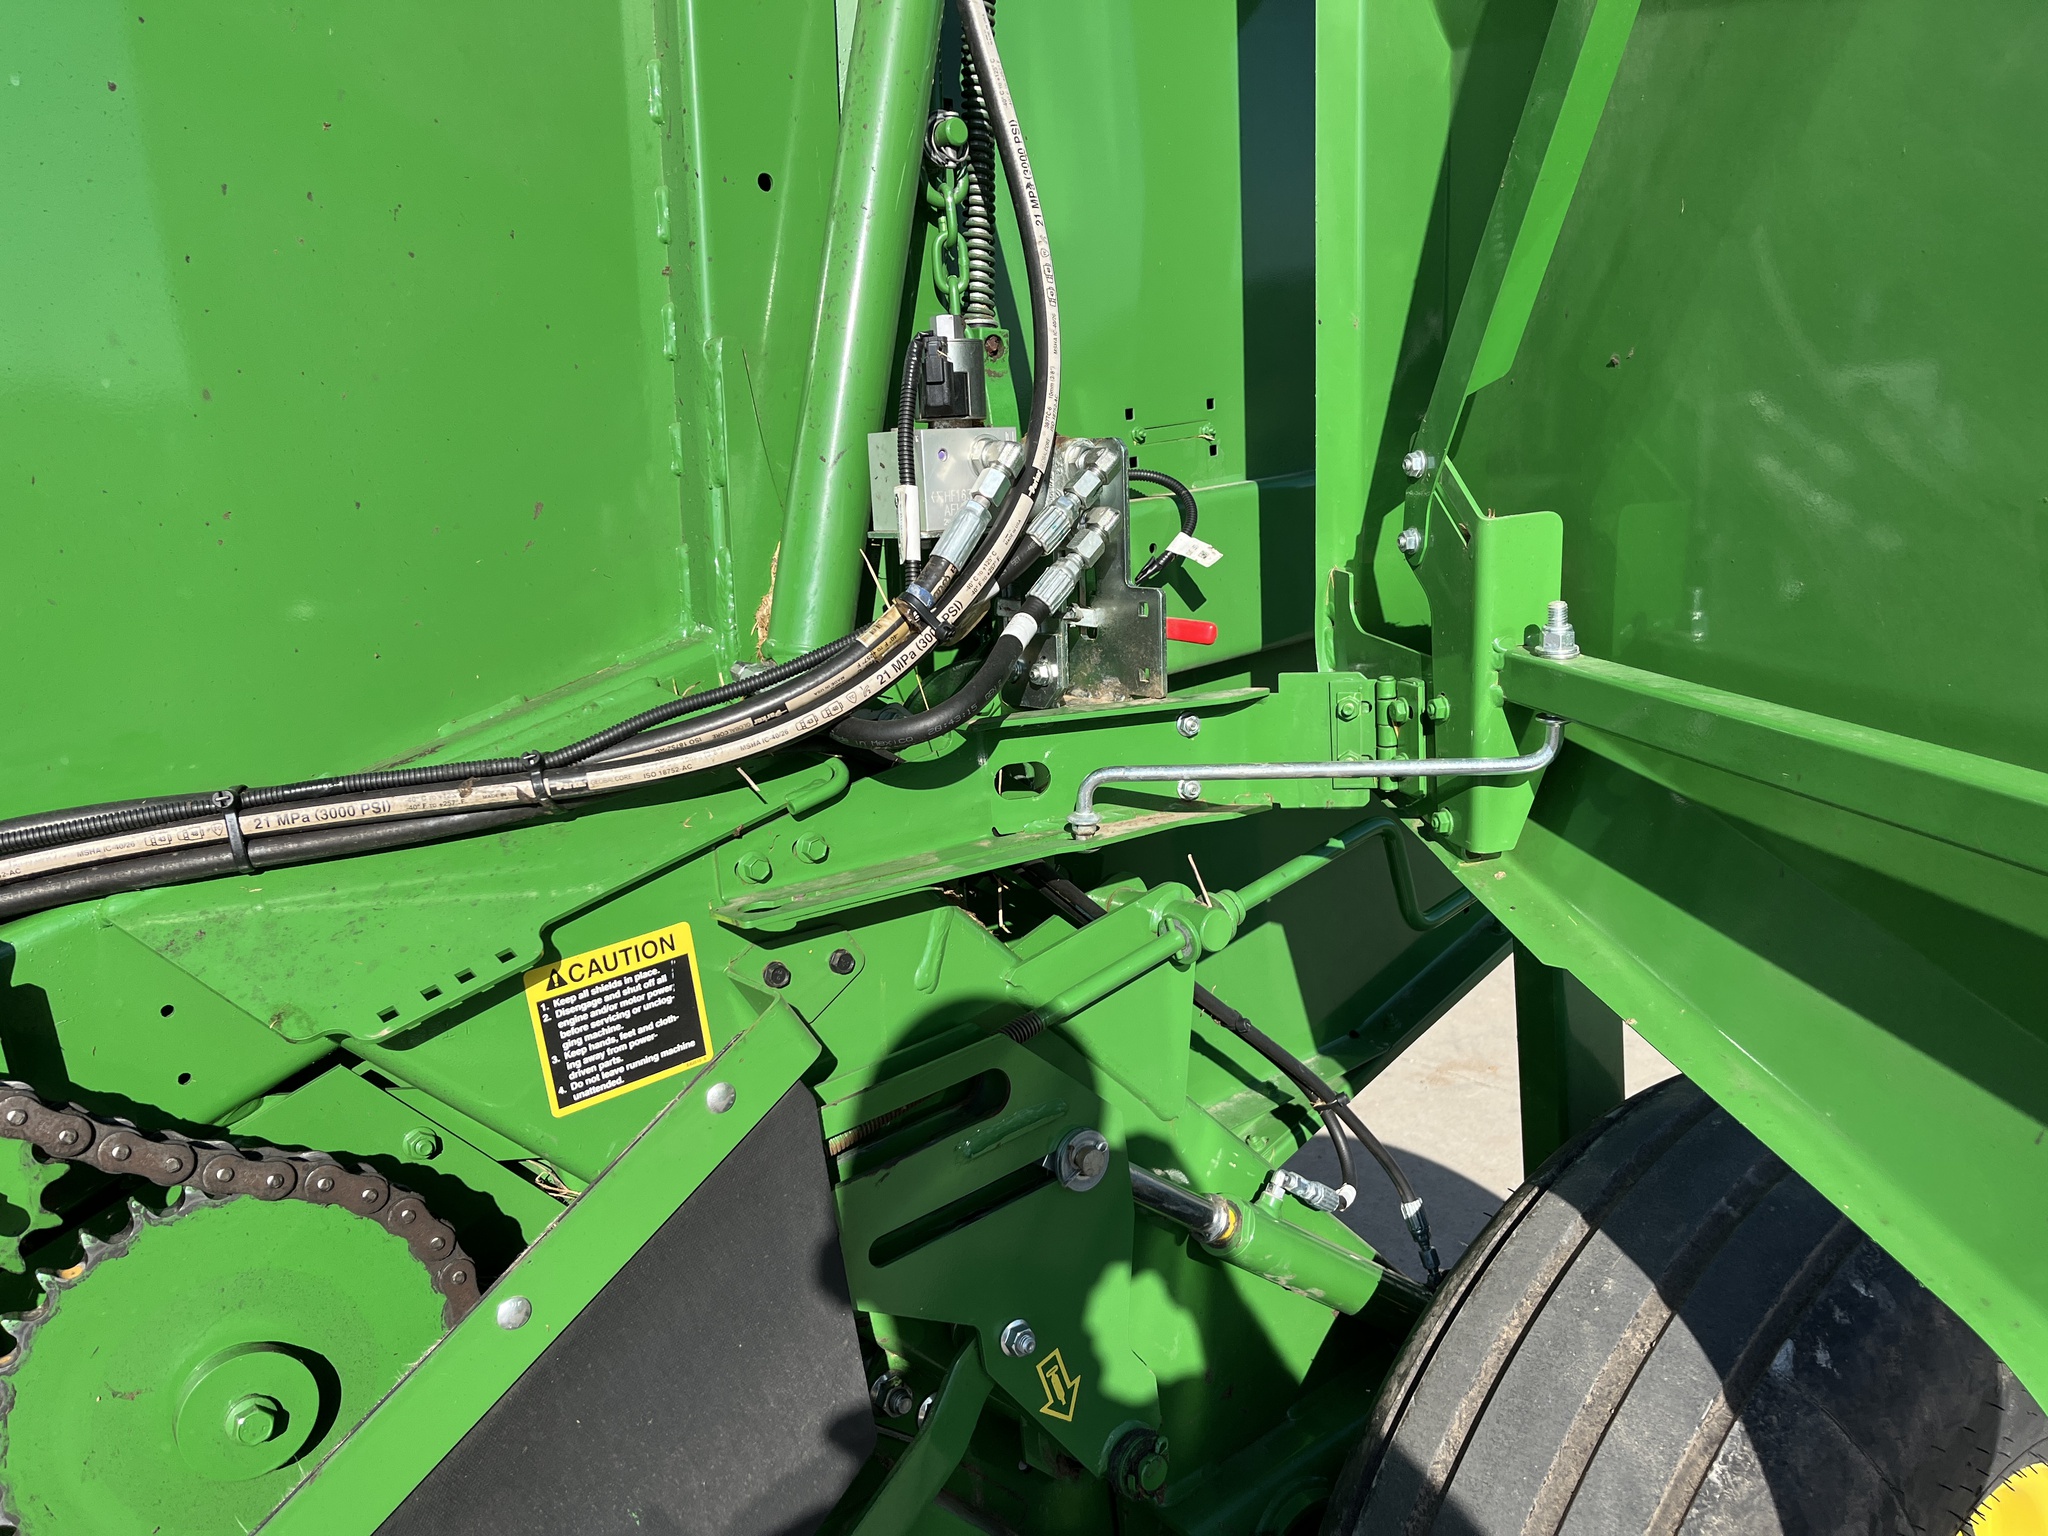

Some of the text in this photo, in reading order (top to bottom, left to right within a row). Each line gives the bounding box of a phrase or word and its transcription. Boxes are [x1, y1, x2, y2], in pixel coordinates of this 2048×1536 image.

[1008, 119, 1023, 145] PSI)
[1035, 214, 1044, 226] 21
[876, 670, 892, 686] 21
[891, 651, 917, 674] MPa
[941, 601, 964, 625] PSI)
[740, 740, 762, 752] MSHA
[871, 736, 914, 747] Mexico
[643, 771, 657, 780] ISO
[254, 799, 391, 829] 21 MPa (3000 PSI)
[77, 846, 101, 858] MSHA
[568, 933, 676, 983] CAUTION
[540, 968, 661, 1012] 1. Keep all shields in place.
[542, 973, 668, 1023] 2. Disengage and shut off all
[557, 1011, 589, 1030] engine
[590, 1002, 618, 1019] and/or
[619, 993, 646, 1008] motor
[559, 995, 676, 1040] before servicing or unclog-
[551, 1014, 680, 1065] 3. Keep hands, feet and cloth-
[562, 1023, 625, 1051] ging machine.
[557, 1039, 697, 1096] 4. Do not leave running machine
[566, 1033, 659, 1072] ing away from power-
[568, 1056, 625, 1081] driven parts.
[572, 1075, 625, 1102] unattended.
